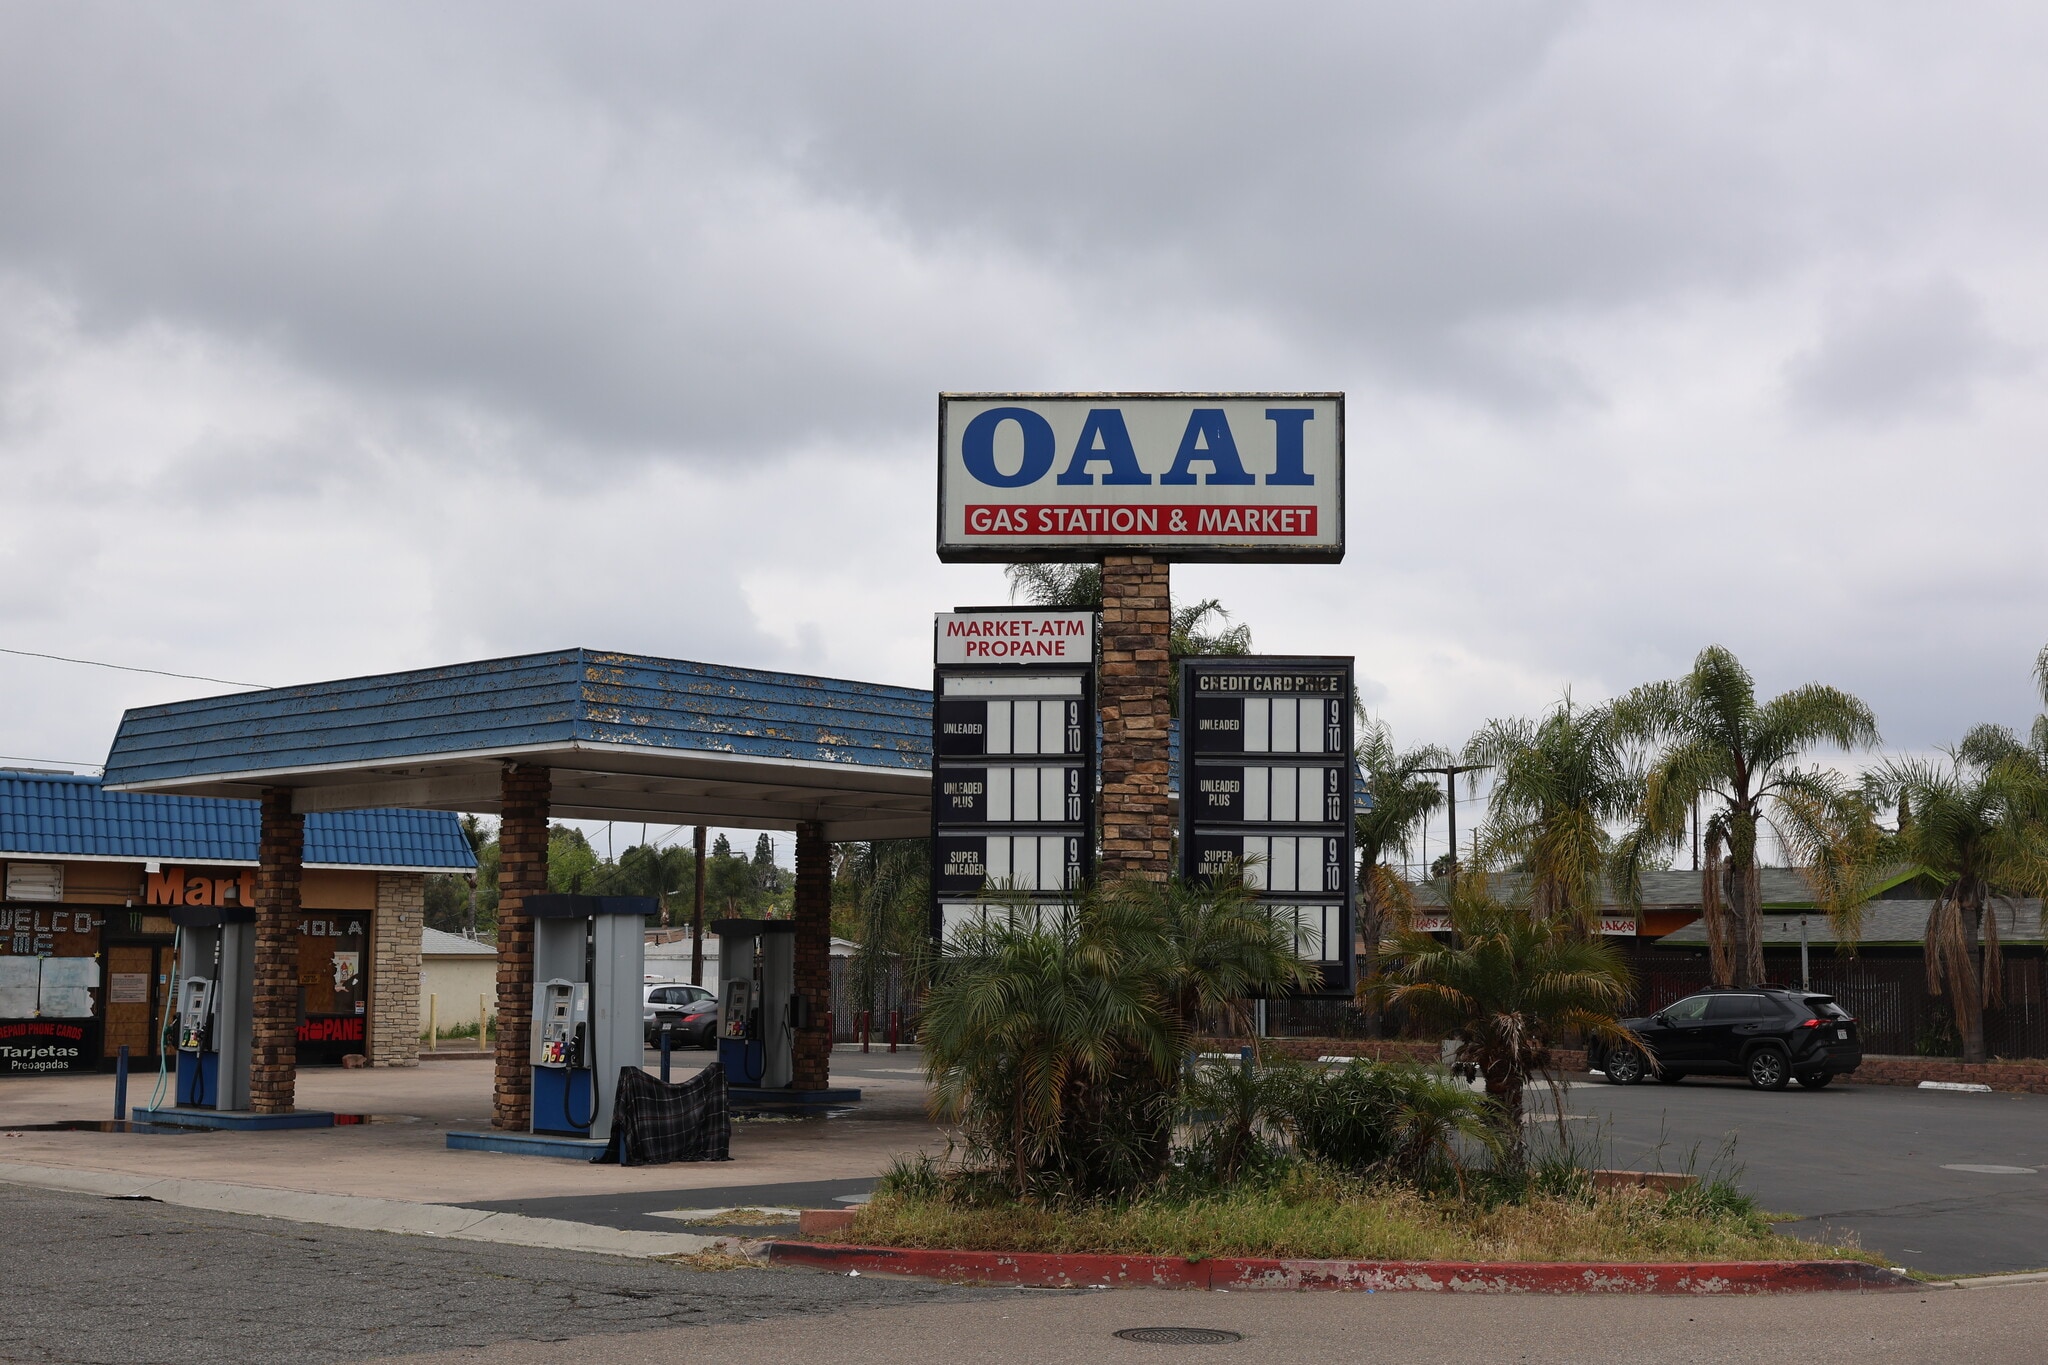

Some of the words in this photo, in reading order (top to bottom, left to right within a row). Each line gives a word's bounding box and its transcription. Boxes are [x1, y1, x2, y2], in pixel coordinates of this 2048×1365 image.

[961, 407, 1315, 488] OAAI
[970, 508, 1028, 533] GAS
[1038, 508, 1158, 533] STATION
[1168, 508, 1188, 533] &
[1197, 509, 1312, 533] MARKET
[947, 620, 1085, 637] MARKET-ATM
[966, 640, 1066, 657] PROPANE
[1200, 676, 1251, 691] CREDIT
[1253, 676, 1292, 691] CARD
[1070, 701, 1078, 725] 9
[1331, 700, 1339, 724] 9
[943, 723, 983, 734] UNLEADED
[1199, 719, 1240, 731] UNLEADED
[1068, 728, 1081, 753] 10
[1328, 728, 1341, 753] 10
[944, 782, 983, 795] UNLEADED
[1070, 769, 1079, 793] 9
[1200, 780, 1240, 793] UNLEADED
[1330, 769, 1338, 793] 9
[952, 796, 974, 808] PLUS
[1068, 797, 1081, 821] 10
[1208, 794, 1230, 807] PLUS
[1327, 796, 1340, 821] 10
[950, 851, 979, 863] SUPER
[1070, 838, 1078, 862] 9
[1204, 850, 1233, 862] SUPER
[1329, 838, 1337, 863] 9
[944, 863, 985, 876] UNLEADED
[1326, 866, 1340, 891] 10
[146, 867, 256, 908] Mart
[28, 1022, 55, 1036] PHONE
[56, 1024, 83, 1041] CARDS
[0, 1045, 79, 1059] Tarjetas
